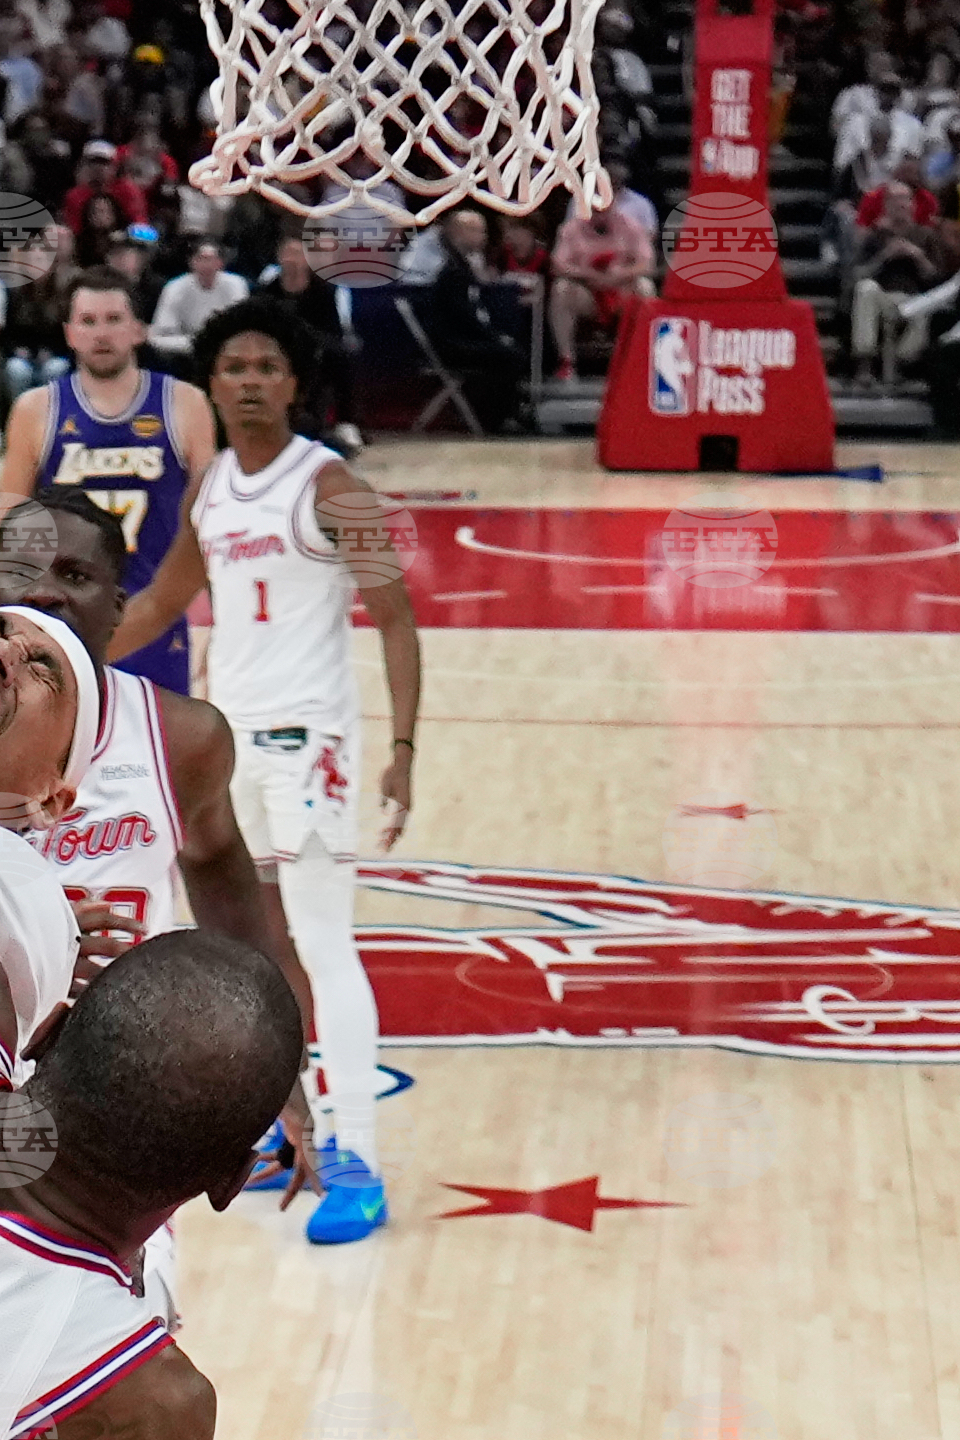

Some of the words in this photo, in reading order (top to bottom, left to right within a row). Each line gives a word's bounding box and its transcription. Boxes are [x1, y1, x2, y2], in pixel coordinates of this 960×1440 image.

[697, 320, 797, 375] League
[696, 367, 767, 415] Pass
[253, 577, 271, 624] 1
